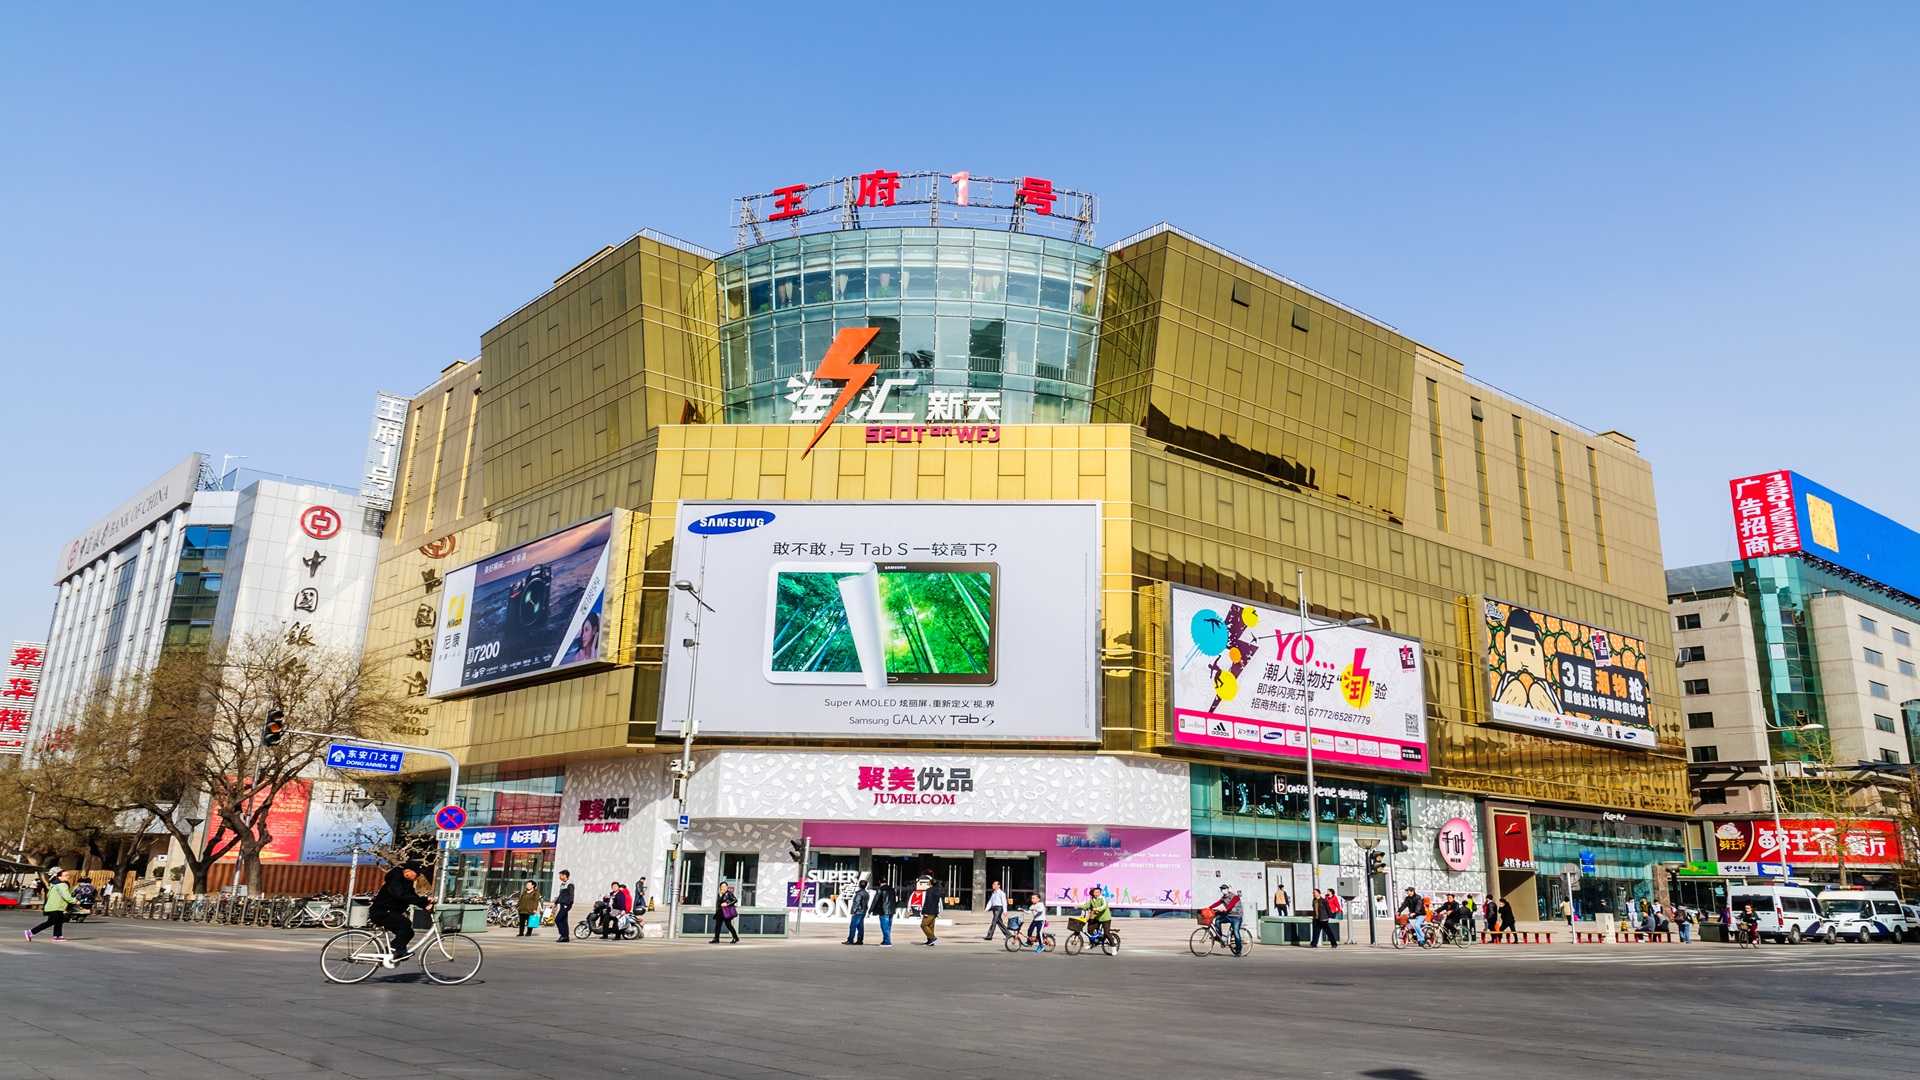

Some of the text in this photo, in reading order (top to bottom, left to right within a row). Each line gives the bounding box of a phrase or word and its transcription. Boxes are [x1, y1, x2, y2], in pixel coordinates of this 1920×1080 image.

[769, 169, 1058, 221] 王府1号
[926, 390, 1000, 421] 新天
[866, 426, 926, 443] SPOT
[955, 426, 1001, 443] WFJ
[366, 397, 404, 491] 王府1号
[142, 485, 169, 514] CHINA
[700, 517, 765, 528] SAMSUNG
[1735, 479, 1771, 556] 广告招商
[860, 542, 892, 556] Tab
[897, 542, 908, 556] S
[446, 618, 463, 629] Nikon
[467, 641, 500, 665] D7200
[1257, 682, 1316, 703] 即将闪亮开幕
[824, 698, 852, 708] Super
[855, 699, 897, 707] AMOLED
[849, 716, 889, 727] Samsung
[893, 714, 946, 726] GALAXY
[949, 713, 980, 726] Tab
[1294, 705, 1371, 725] 6567772/65267779
[347, 750, 400, 763] 东安门大街
[857, 766, 974, 792] 聚美优品
[873, 793, 956, 806] JUMEI.COM
[578, 797, 630, 821] 聚美优品
[510, 829, 557, 844] 4G手机广场
[808, 870, 860, 883] SUPER
